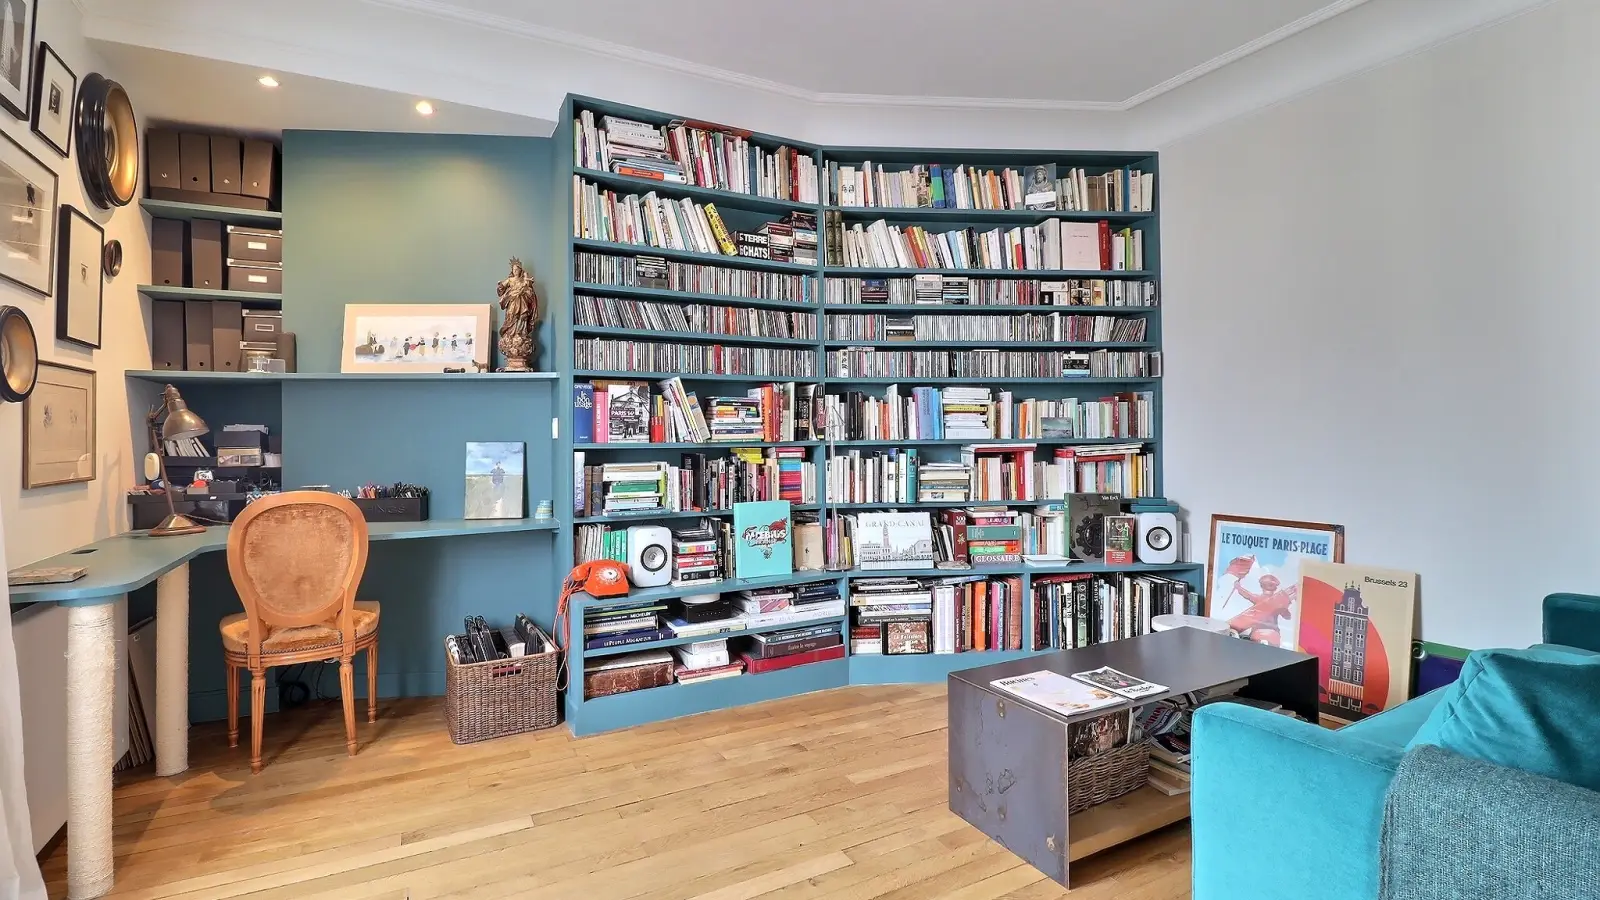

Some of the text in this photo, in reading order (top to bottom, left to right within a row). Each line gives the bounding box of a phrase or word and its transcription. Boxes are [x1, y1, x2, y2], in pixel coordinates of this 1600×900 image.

[744, 233, 768, 244] TERRE
[744, 245, 768, 259] CHATS
[865, 519, 925, 528] GRAND CANAL
[1222, 532, 1328, 556] LE TOUQUET PARIS-PLAGE
[975, 554, 1021, 564] GLOSSAIRE
[1364, 576, 1408, 588] Brussels 23
[1079, 583, 1087, 627] PRADO
